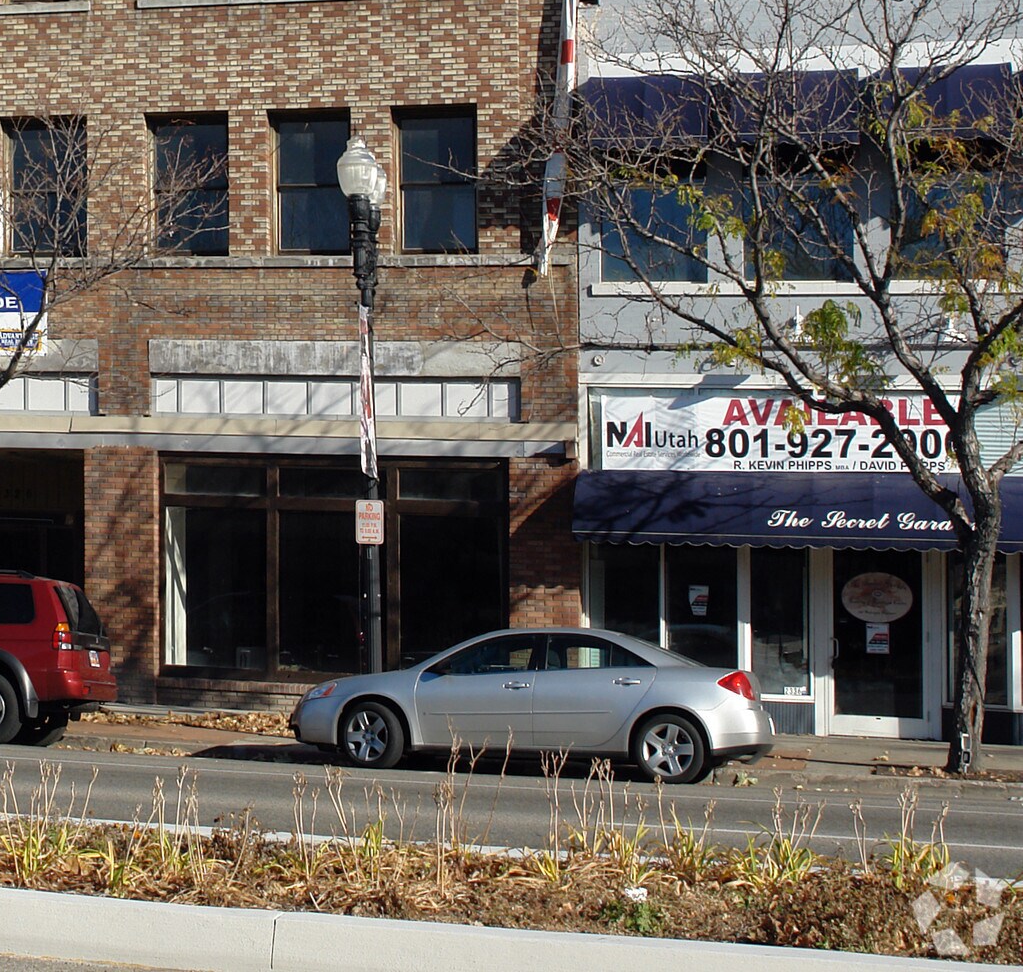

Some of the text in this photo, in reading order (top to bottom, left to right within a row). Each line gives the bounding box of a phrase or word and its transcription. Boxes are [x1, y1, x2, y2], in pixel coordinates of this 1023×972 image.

[606, 411, 699, 448] NAI Utah
[733, 460, 745, 470] R.
[749, 460, 784, 470] KEVIN
[788, 460, 833, 471] PHIPPS
[859, 460, 897, 470] DAVID
[900, 460, 946, 471] PPPS
[358, 512, 381, 521] PARKING
[767, 509, 814, 528] The
[821, 510, 891, 529] Secret
